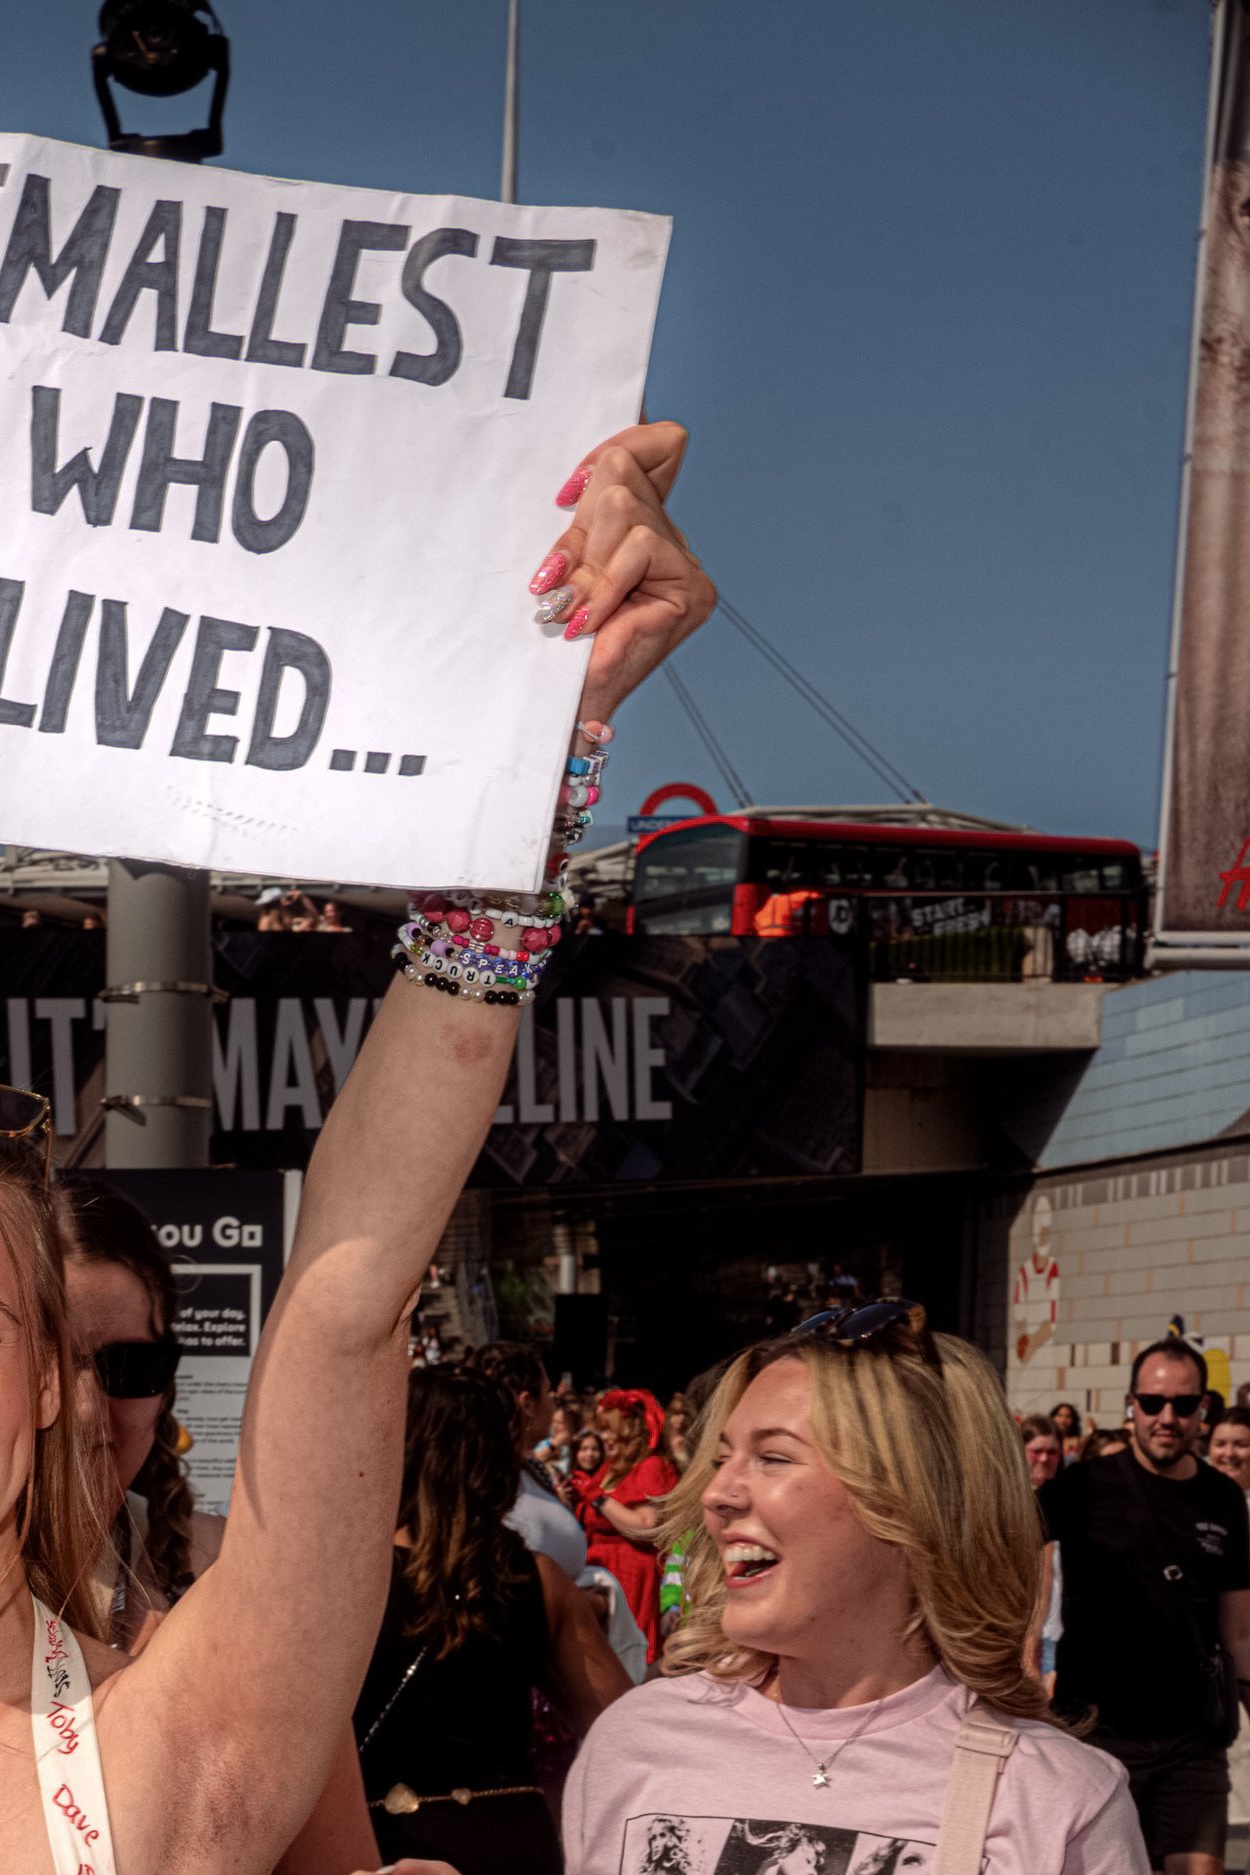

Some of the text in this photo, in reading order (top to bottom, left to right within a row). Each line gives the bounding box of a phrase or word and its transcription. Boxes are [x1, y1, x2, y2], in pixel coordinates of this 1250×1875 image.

[29, 384, 316, 555] WHO
[203, 1321, 247, 1334] Explore
[46, 1700, 80, 1756] Toby
[51, 1783, 100, 1848] Dave
